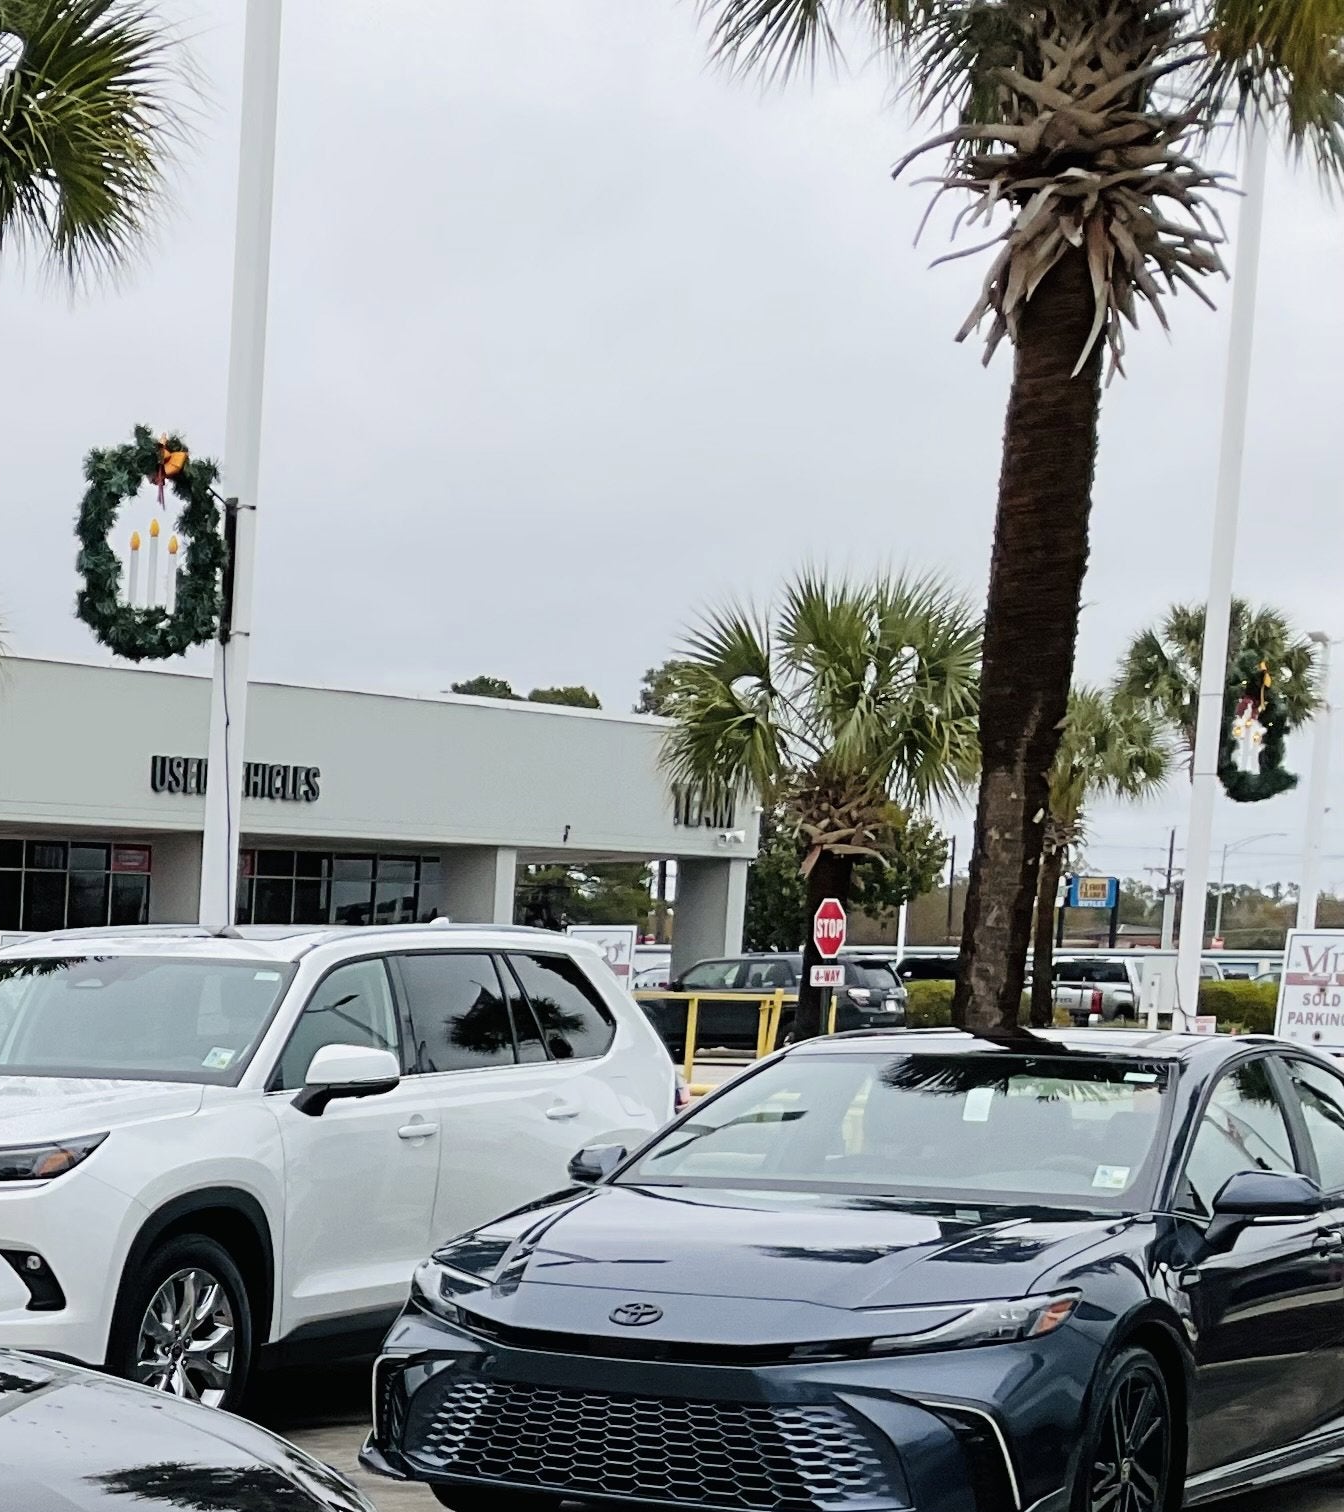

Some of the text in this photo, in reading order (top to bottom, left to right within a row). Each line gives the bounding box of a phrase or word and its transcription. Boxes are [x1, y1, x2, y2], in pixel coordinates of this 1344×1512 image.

[242, 762, 321, 802] HICLES
[817, 918, 844, 939] STOP
[815, 970, 841, 982] 4-WAY
[1302, 992, 1341, 1008] SOLD
